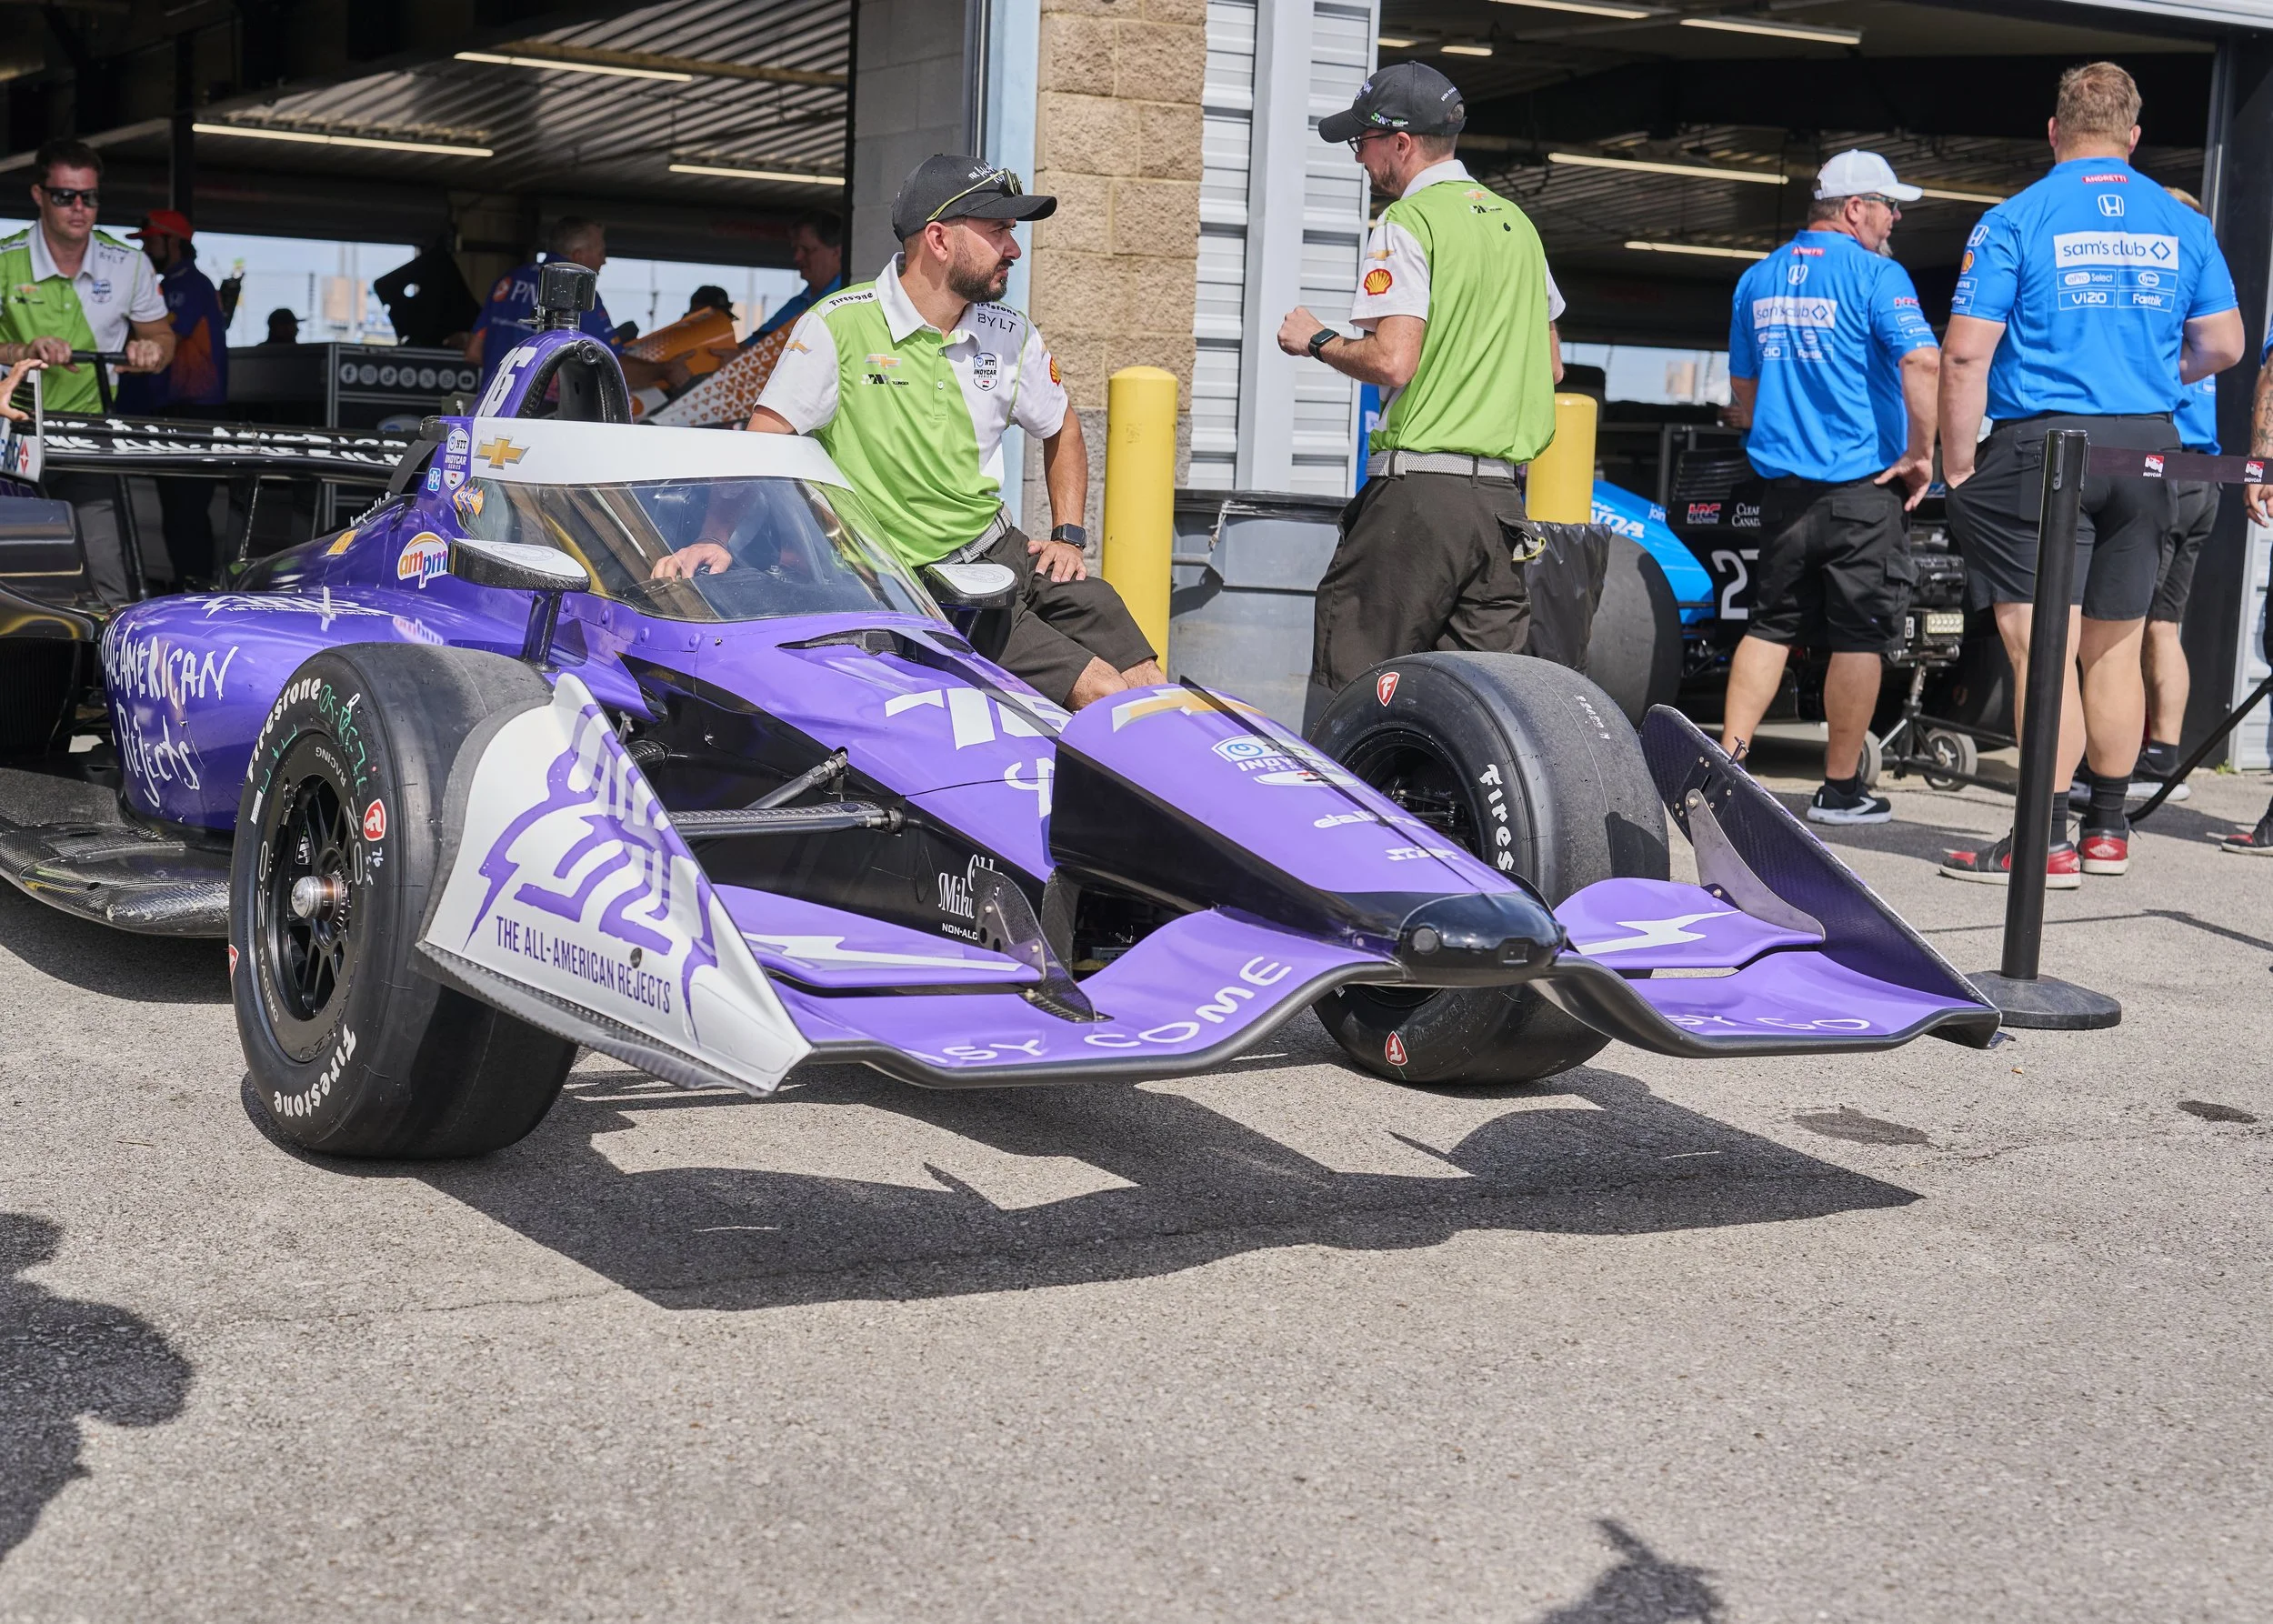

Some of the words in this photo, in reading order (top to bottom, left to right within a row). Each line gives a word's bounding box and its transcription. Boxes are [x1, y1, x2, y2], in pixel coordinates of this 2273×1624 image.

[2085, 175, 2128, 183] ANDRETTI
[2063, 241, 2110, 257] sam's
[2112, 239, 2147, 257] club
[2091, 273, 2113, 283] Select
[510, 280, 539, 306] PN
[829, 292, 874, 306] Firestone
[2071, 292, 2108, 305] VIZIO
[976, 302, 1017, 317] irestone
[977, 312, 1016, 333] BYLT
[456, 439, 467, 450] NTT
[444, 455, 467, 466] INDYCAR
[1591, 508, 1645, 538] NDA
[398, 550, 447, 585] ampm
[1478, 764, 1515, 870] Fires
[942, 922, 978, 941] NON-ALC
[496, 915, 520, 953] THE
[524, 926, 616, 990] ALL-AMERICAN
[617, 962, 672, 1015] REJECTS
[1083, 955, 1293, 1048] COME
[1755, 1017, 1871, 1030] GO
[274, 1023, 357, 1118] Firestone
